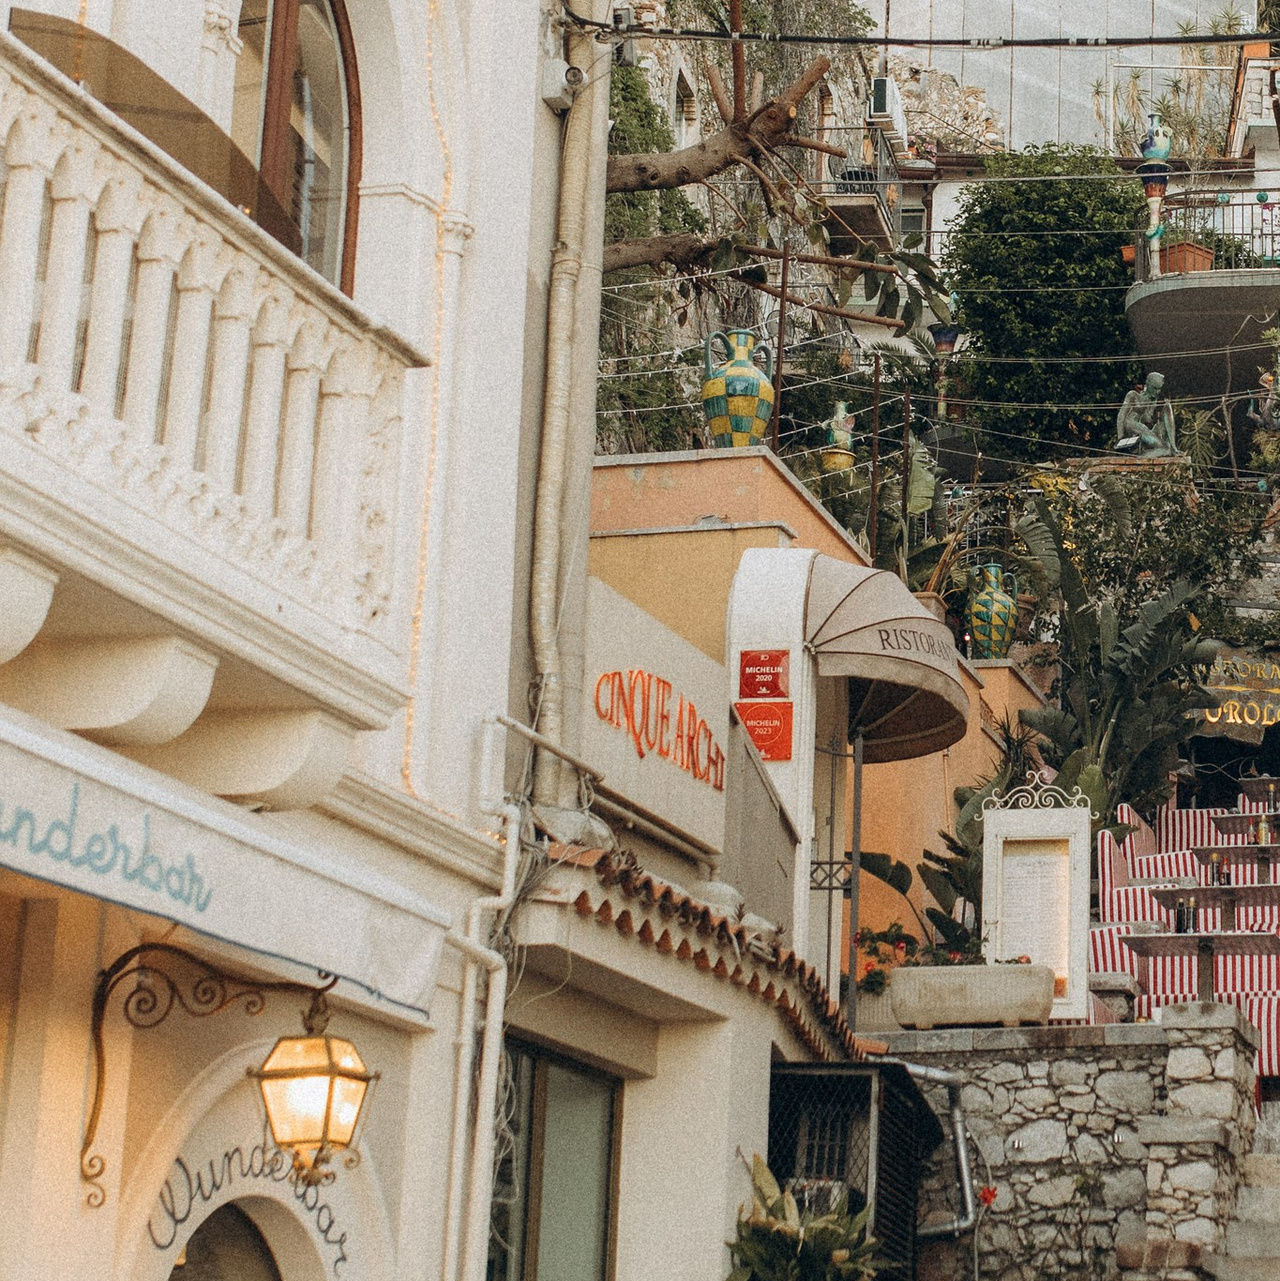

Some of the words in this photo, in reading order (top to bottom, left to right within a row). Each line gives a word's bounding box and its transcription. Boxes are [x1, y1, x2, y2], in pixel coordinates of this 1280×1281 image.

[745, 666, 783, 674] MICHELIN
[755, 674, 773, 682] 2020
[746, 719, 780, 727] MICHELIN
[594, 670, 672, 759] CINQUE
[673, 692, 725, 792] ARCHI
[754, 727, 772, 735] 2023
[0, 782, 213, 913] nderbar
